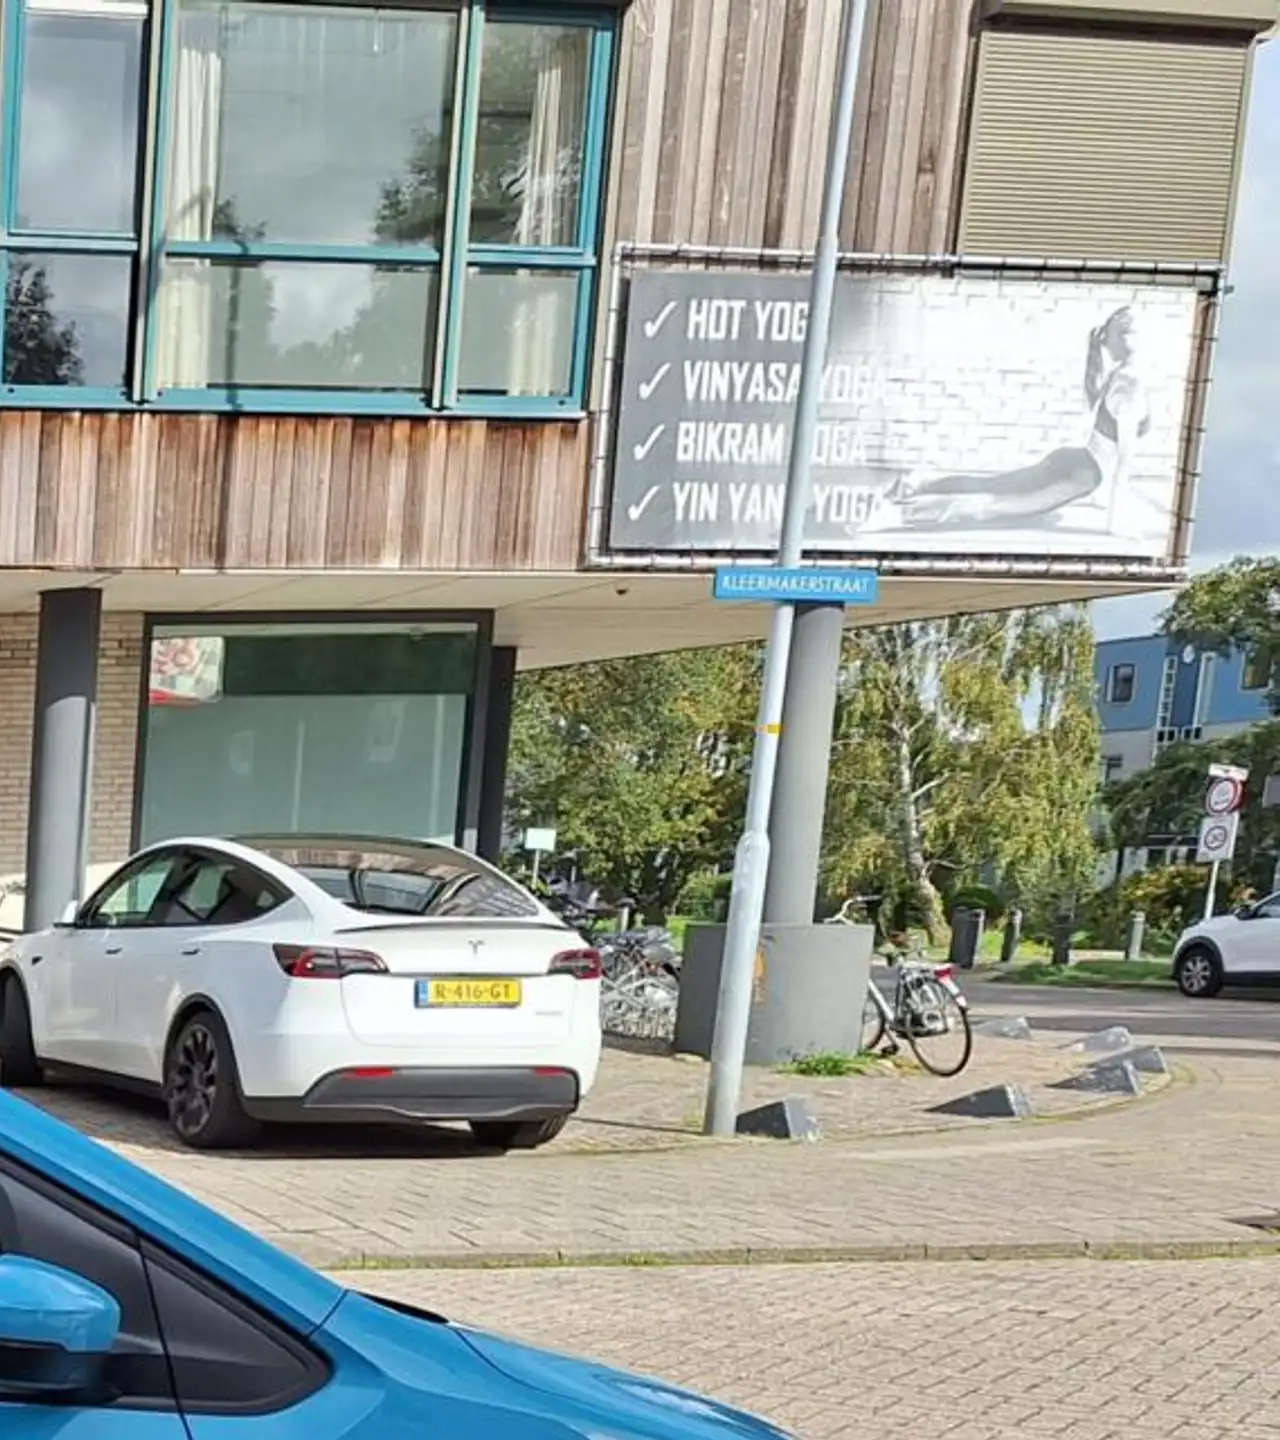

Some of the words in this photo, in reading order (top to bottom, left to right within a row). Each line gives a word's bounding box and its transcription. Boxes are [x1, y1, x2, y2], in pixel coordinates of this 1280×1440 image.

[686, 298, 747, 341] HOT
[753, 300, 810, 343] YOG
[683, 359, 801, 404] VINYASA
[676, 420, 785, 466] BIKRAM
[810, 424, 867, 467] OGA
[672, 480, 720, 523] YIN
[728, 482, 786, 525] YAN
[721, 574, 870, 594] KLEERMAKERSTRAAT
[433, 982, 511, 1000] R-416-GT
